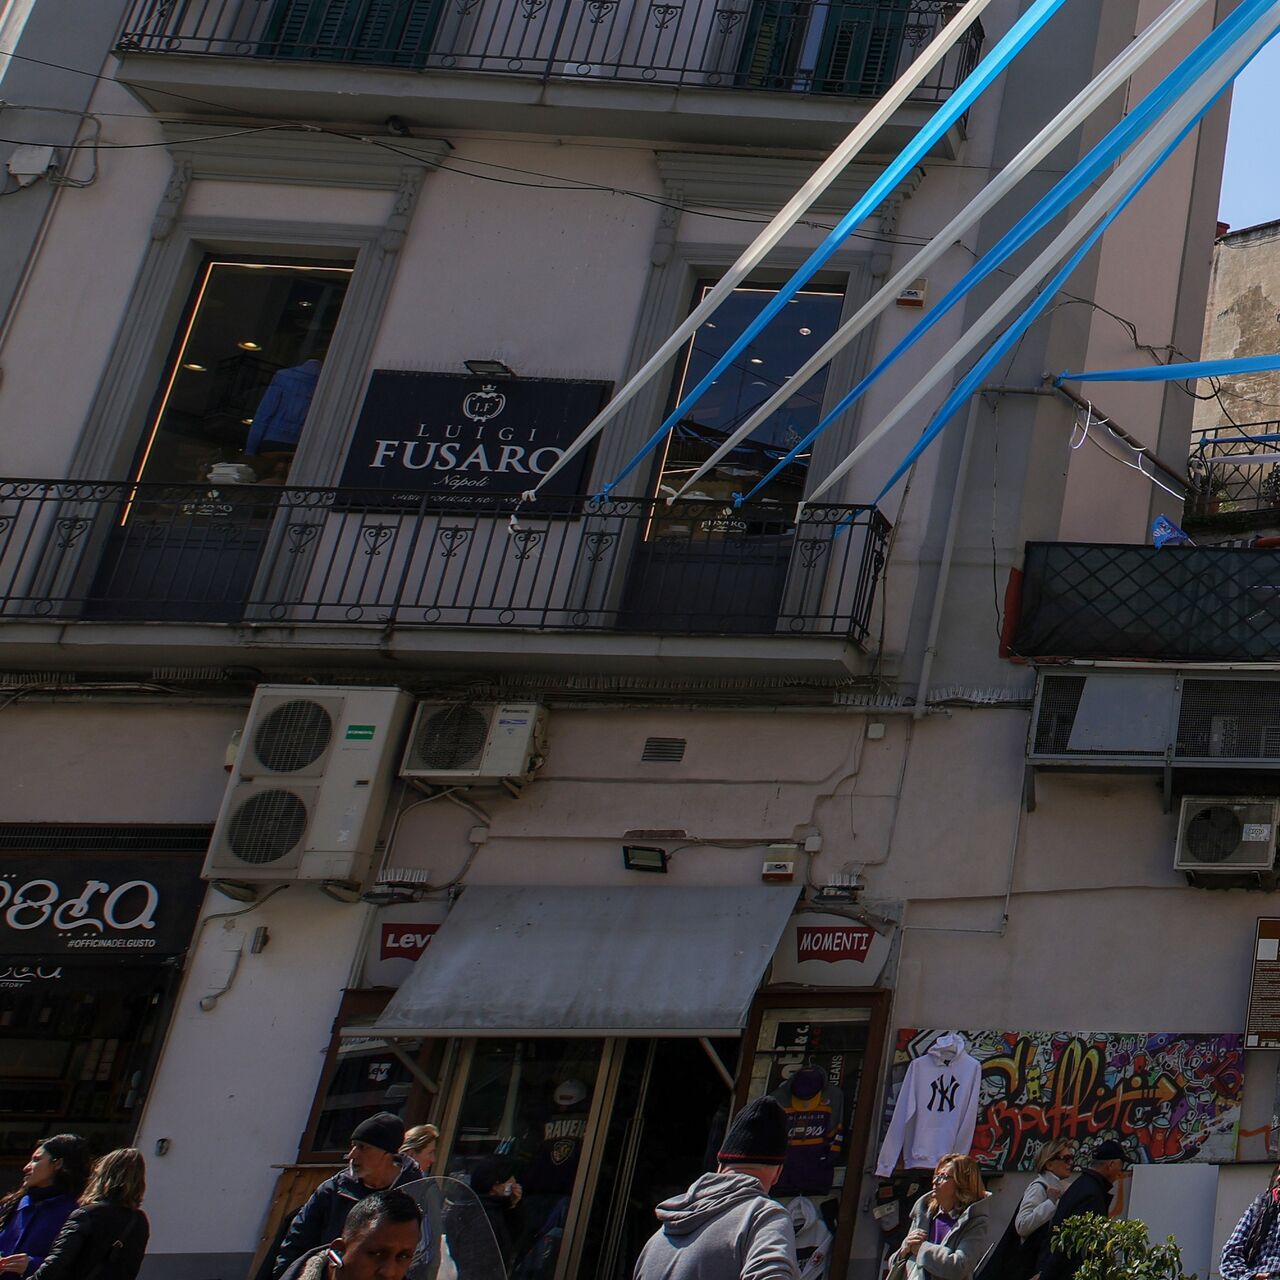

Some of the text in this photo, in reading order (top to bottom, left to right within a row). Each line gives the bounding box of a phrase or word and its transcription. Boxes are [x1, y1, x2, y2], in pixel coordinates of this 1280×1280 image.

[416, 423, 536, 442] LUIGI
[368, 438, 566, 475] FUSARO
[433, 474, 490, 490] Napoli
[67, 938, 156, 948] #OFFICINADELGUSTO
[799, 932, 869, 951] MOMENTI
[829, 1055, 843, 1086] JEANS
